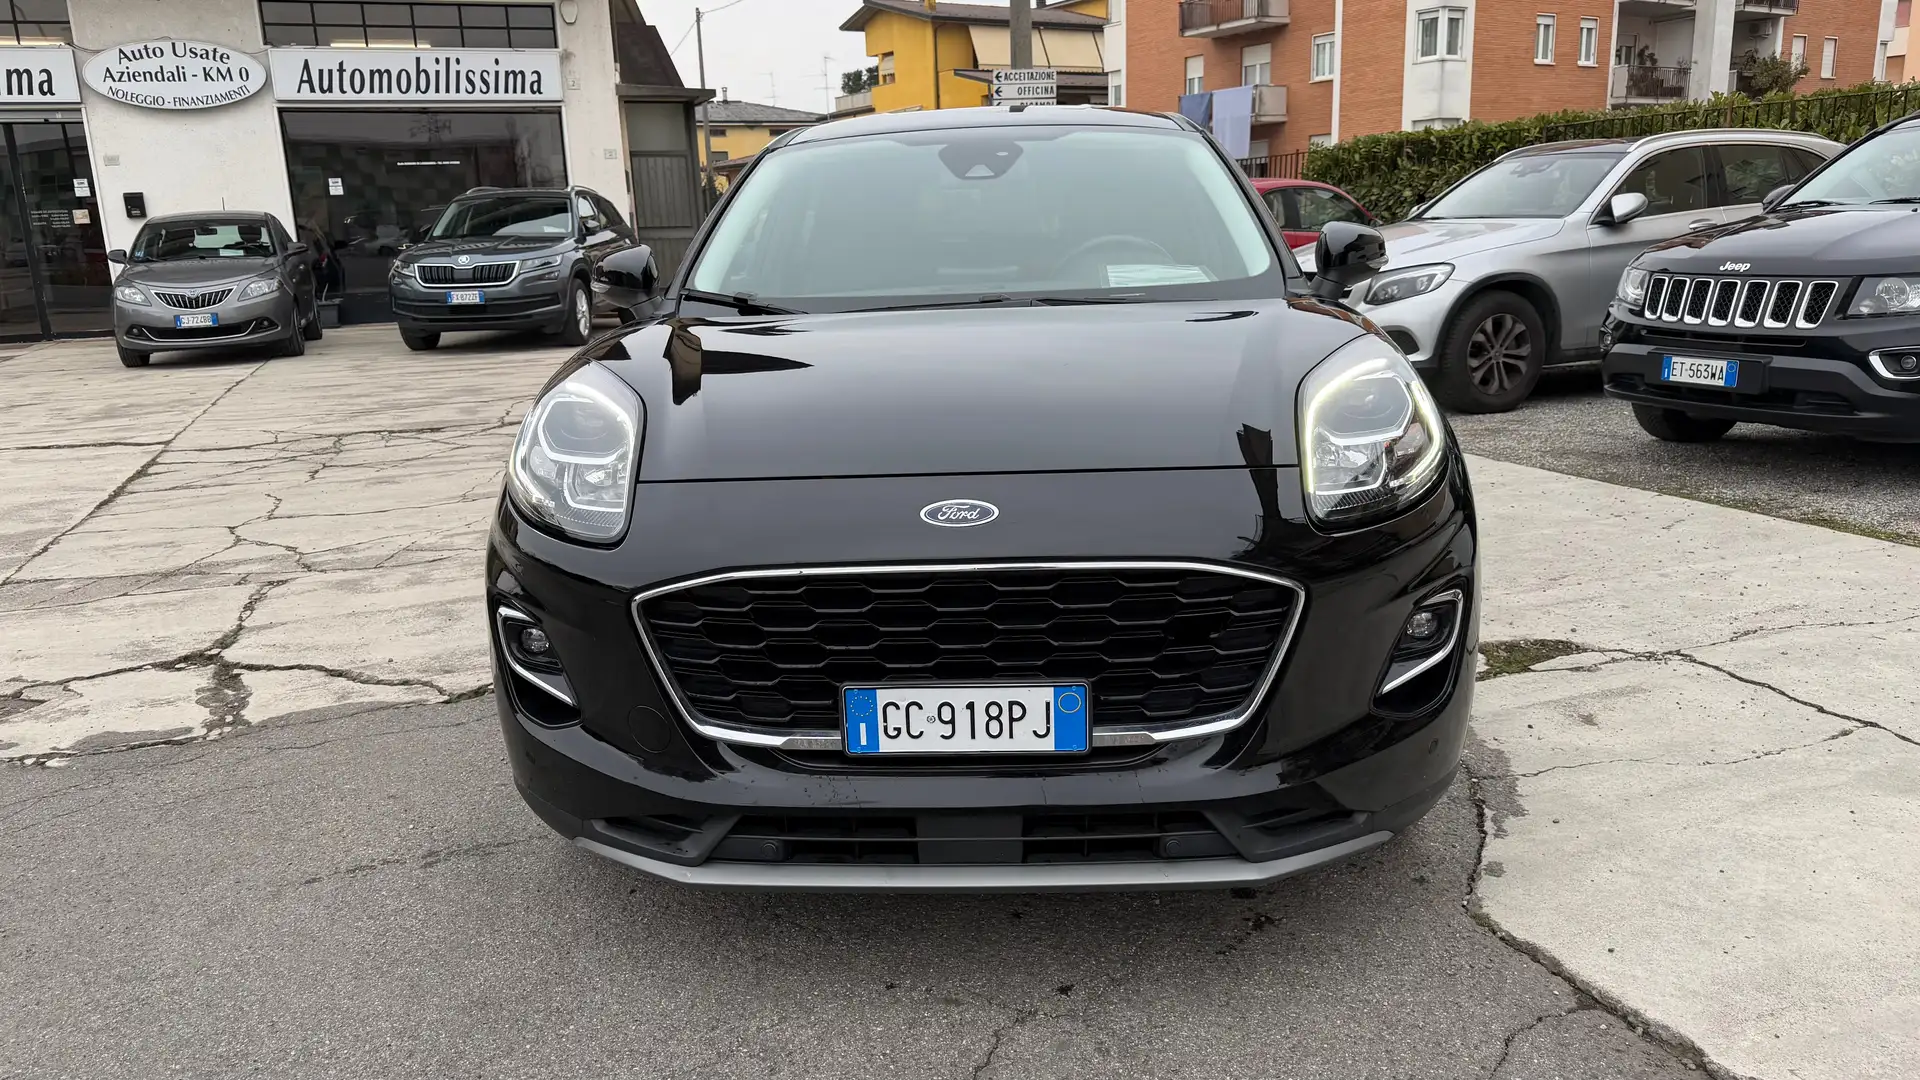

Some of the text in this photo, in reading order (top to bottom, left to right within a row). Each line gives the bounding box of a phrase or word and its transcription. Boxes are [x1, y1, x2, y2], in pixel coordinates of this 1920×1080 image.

[118, 42, 230, 65] Auto Usate
[0, 68, 56, 96] ma
[102, 65, 187, 82] Aziendali
[202, 66, 233, 82] KM
[296, 56, 543, 95] Automobilissima
[1003, 71, 1055, 82] ACCETTAZIONE
[107, 86, 165, 106] NOLEGGIO
[173, 84, 251, 107] FINANZIAMENTI
[1017, 85, 1055, 96] OFFICINA
[1719, 261, 1751, 272] Jeep
[937, 504, 981, 520] Ford
